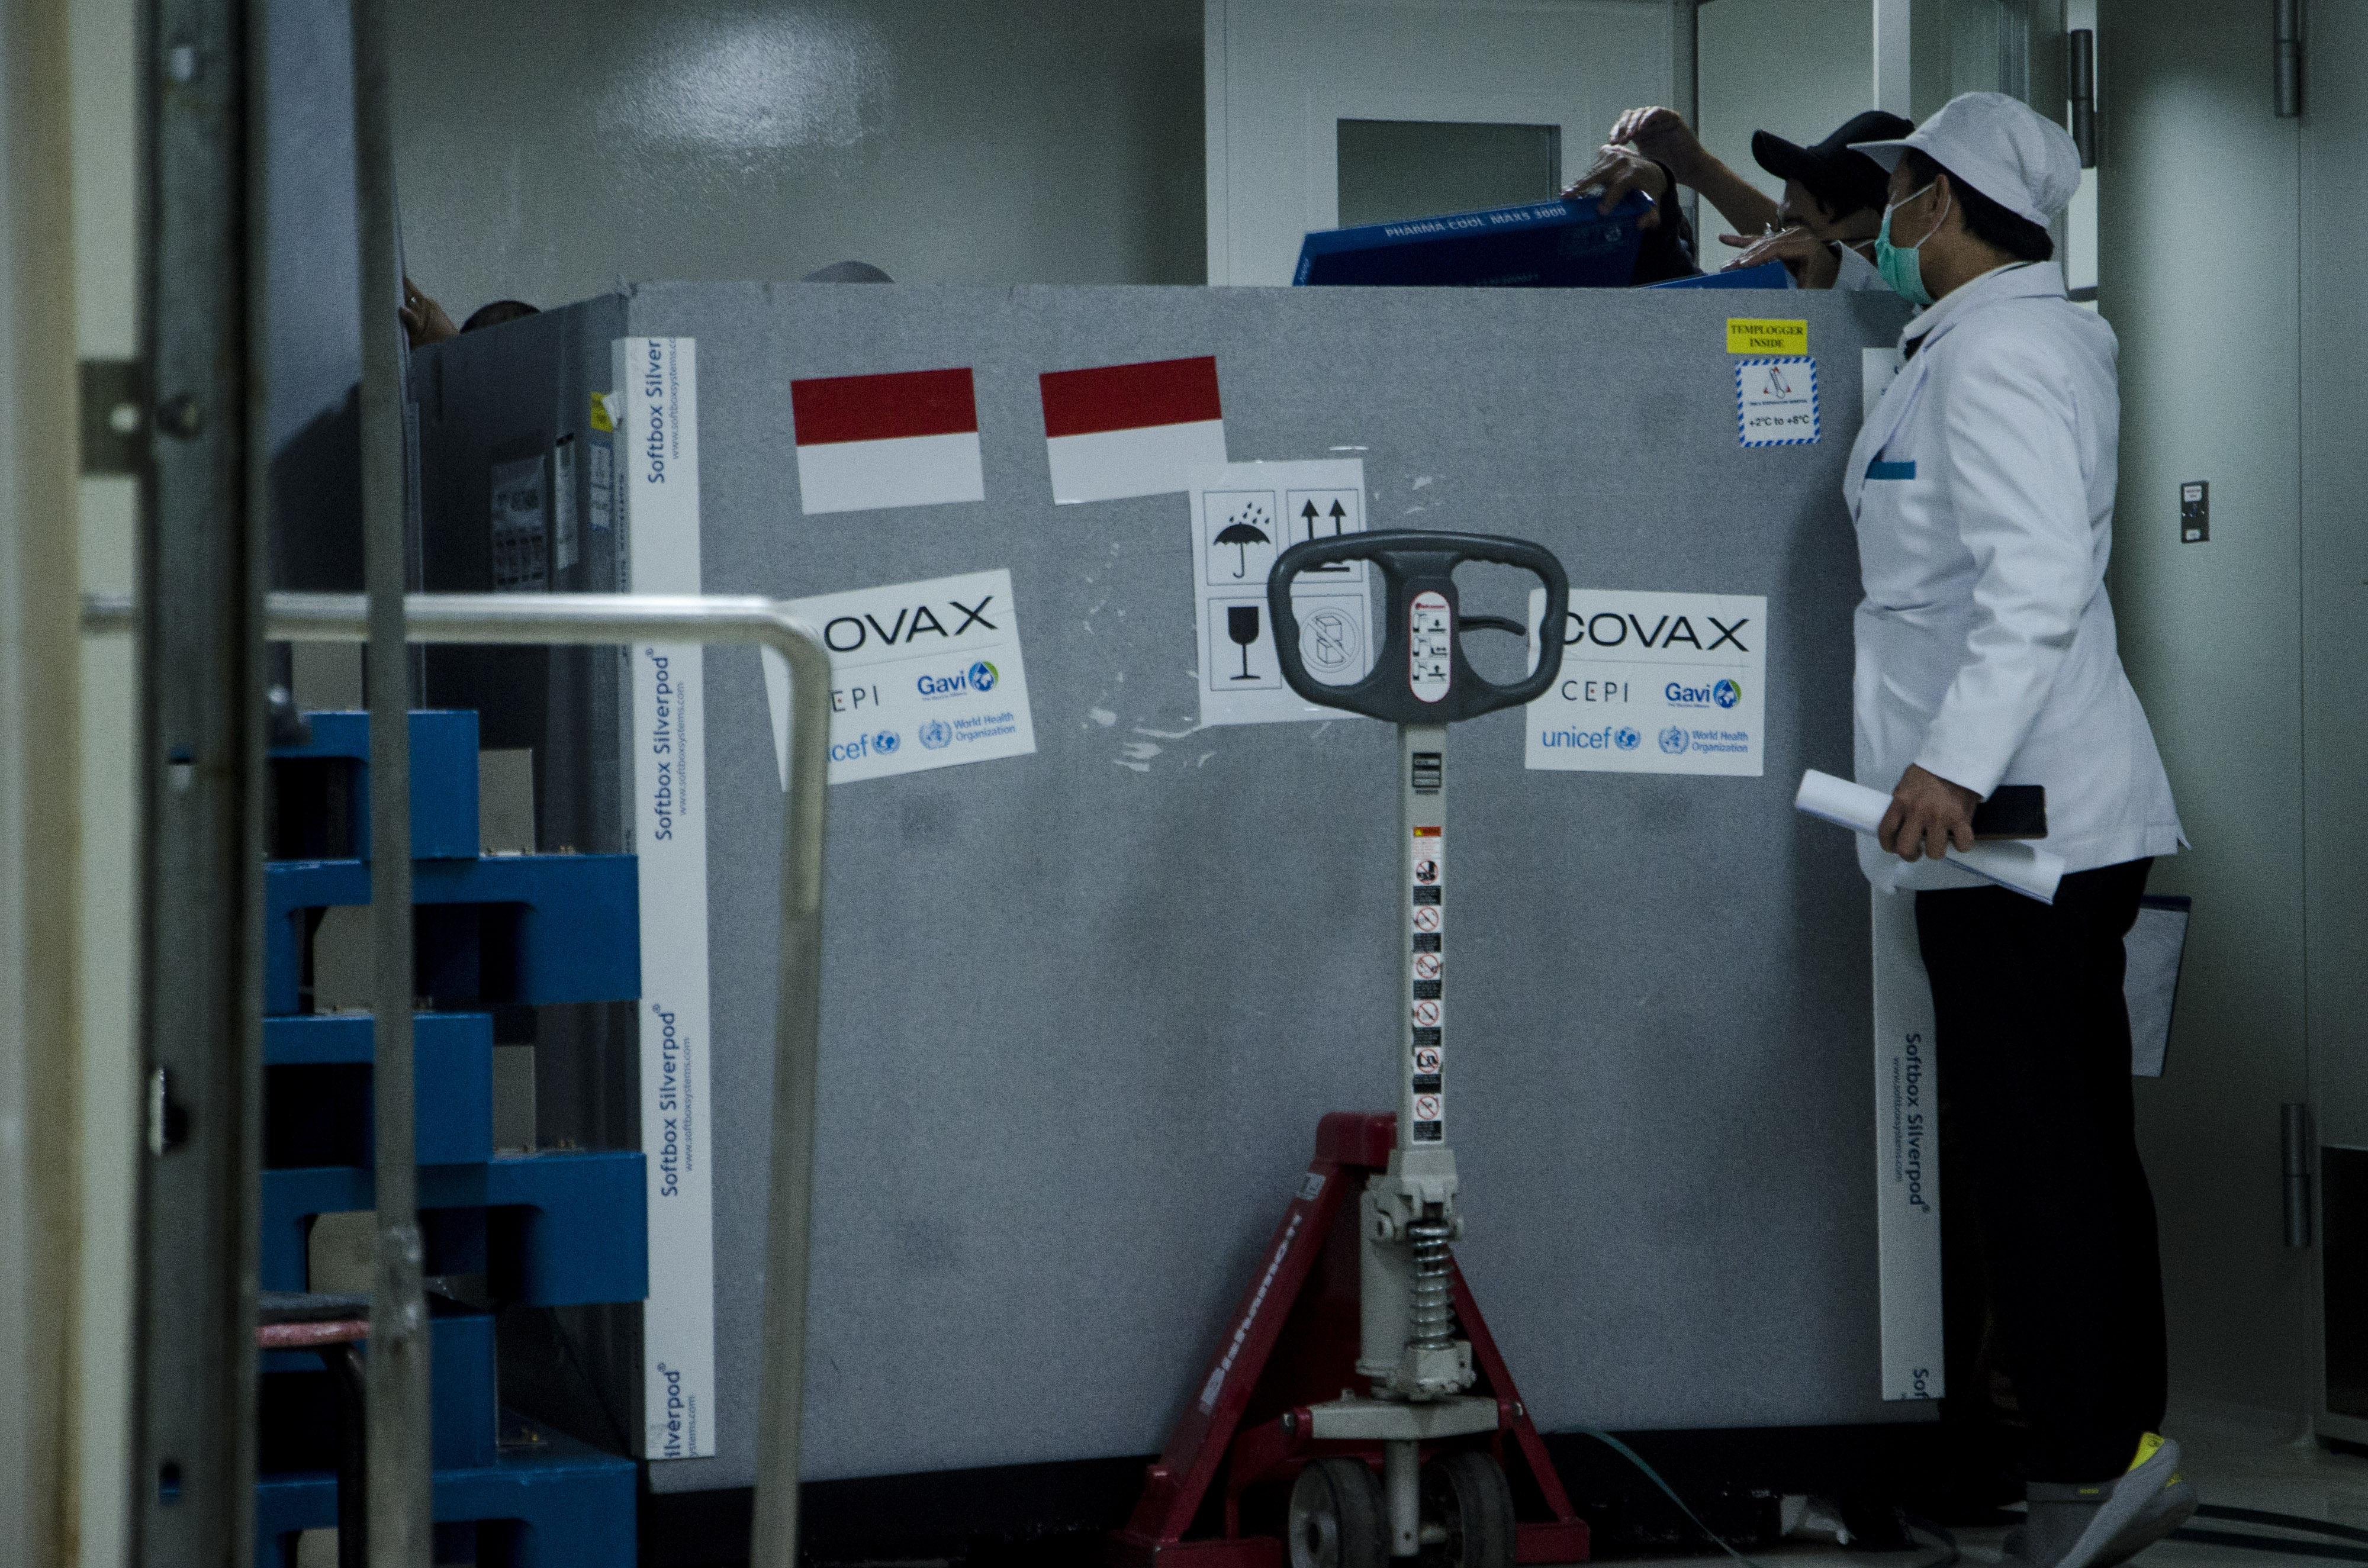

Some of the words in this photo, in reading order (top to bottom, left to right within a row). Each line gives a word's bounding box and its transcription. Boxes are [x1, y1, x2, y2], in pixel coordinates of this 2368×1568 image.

[1731, 325, 1804, 336] TEMPLOGGER
[1749, 339, 1784, 347] INSIDE
[645, 337, 663, 397] Silver
[1775, 416, 1784, 425] to
[646, 405, 665, 484] Softbox
[824, 595, 998, 652] OVAX
[918, 670, 966, 696] Gavi
[1562, 681, 1628, 703] CEPI
[1666, 682, 1710, 703] Gavi
[831, 685, 879, 712] EPI
[953, 716, 981, 730] World
[983, 712, 1014, 725] Health
[955, 725, 1016, 743] Organization
[1543, 726, 1612, 749] unicef
[1693, 730, 1719, 741] World
[1720, 730, 1748, 741] Health
[828, 733, 868, 764] cef
[1692, 742, 1749, 754] Organization
[654, 763, 672, 841] Softbox
[1905, 1033, 1922, 1107] Softbox
[661, 1118, 678, 1197] Softbox
